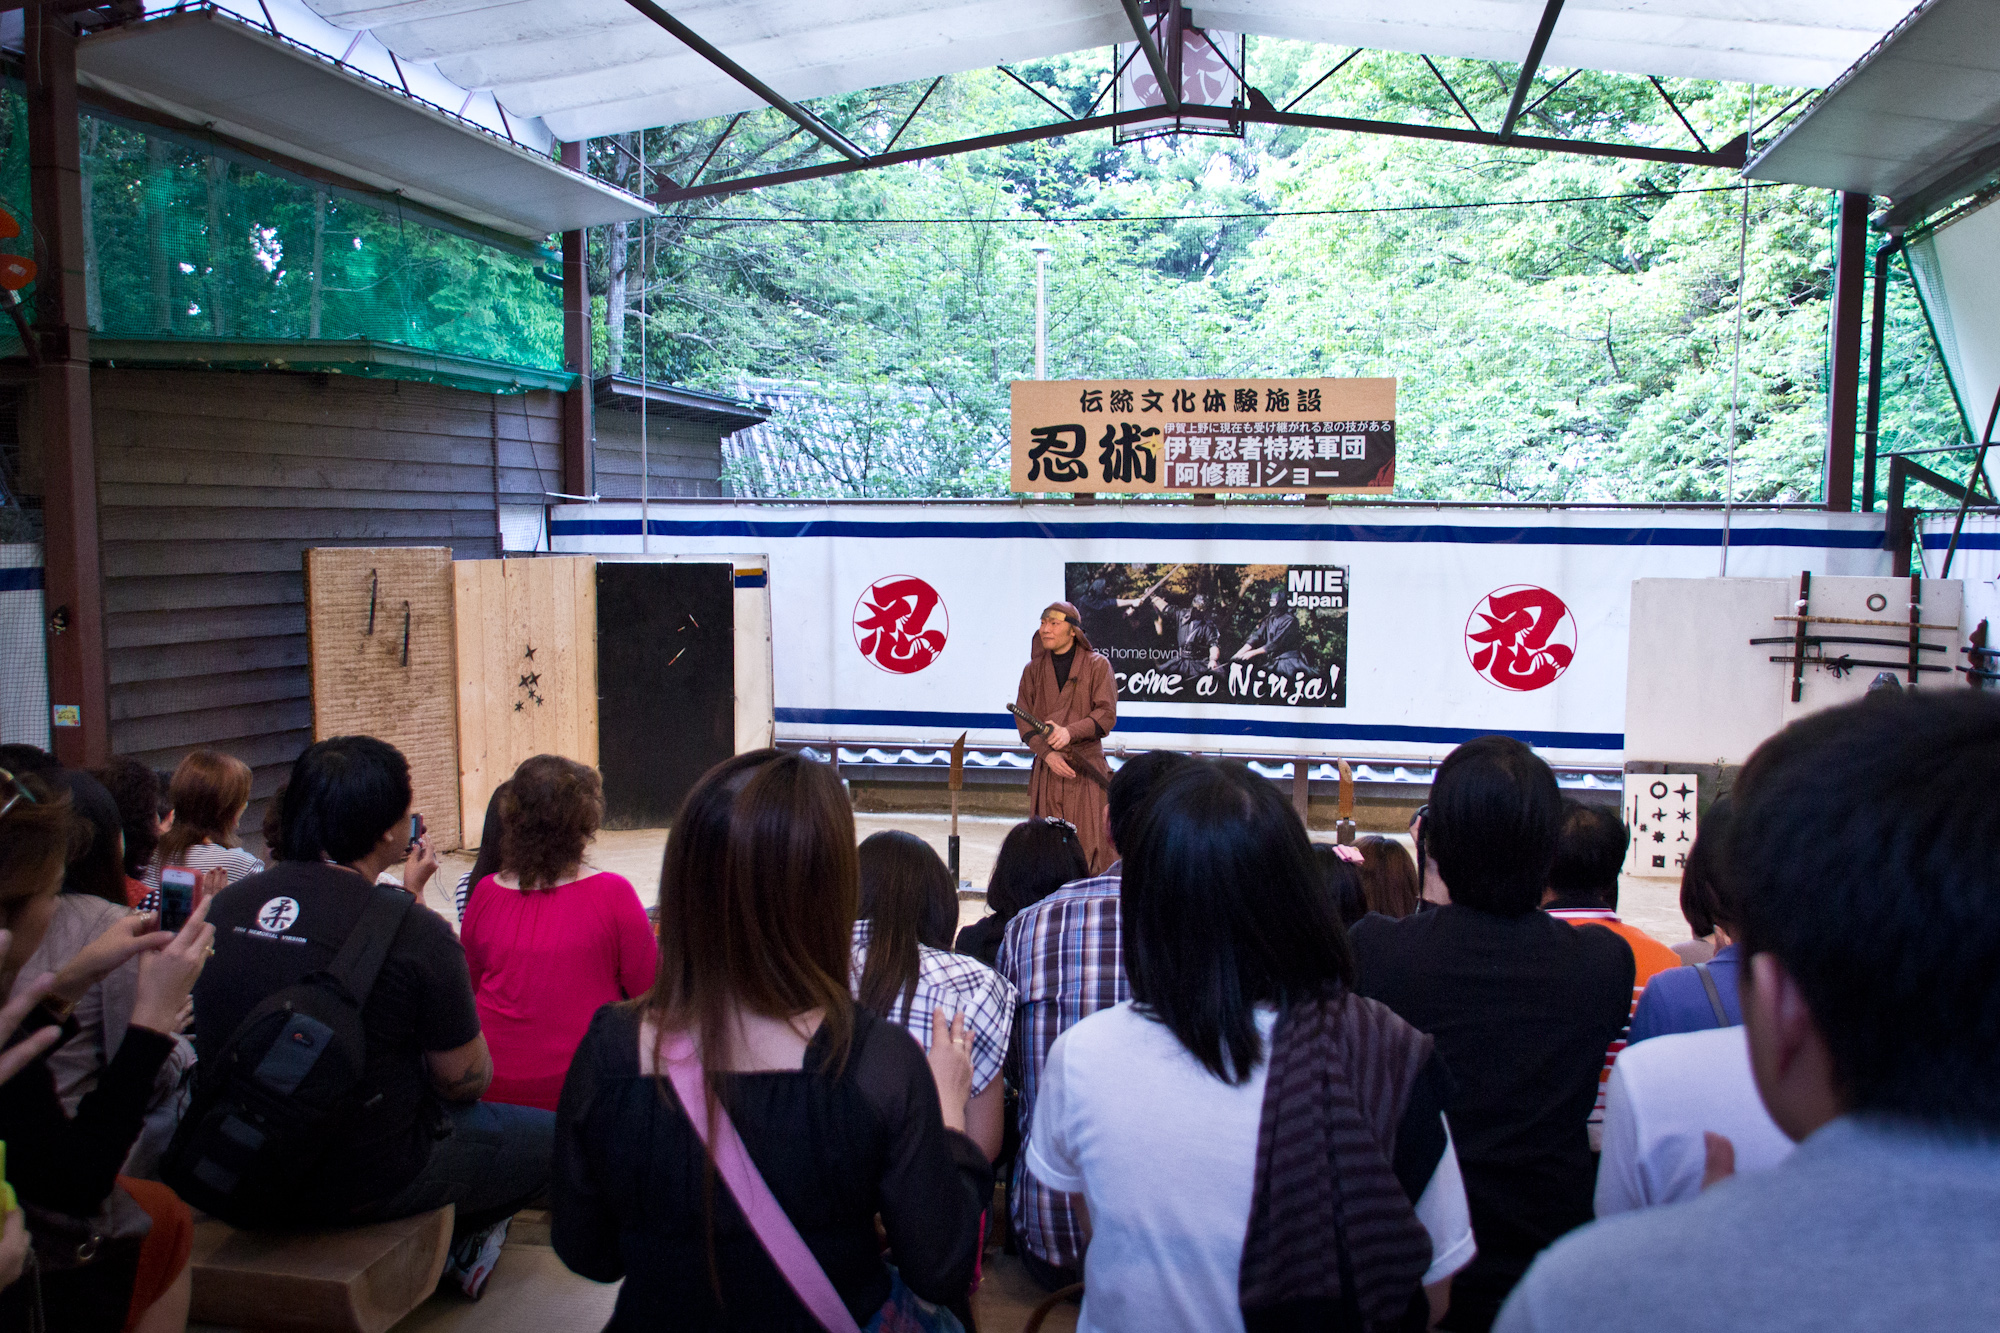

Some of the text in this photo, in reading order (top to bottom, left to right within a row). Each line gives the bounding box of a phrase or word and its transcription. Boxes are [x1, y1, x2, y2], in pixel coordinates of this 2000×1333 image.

[1080, 388, 1322, 414] 伝統文化体験施設
[1164, 421, 1391, 434] 伊賀上野に現在も受け継がれる忍の技がある
[1027, 422, 1161, 484] 忍術
[1164, 435, 1366, 461] 伊賀忍者特殊軍団
[1164, 461, 1340, 488] 「阿修羅」ショー
[1288, 570, 1343, 592] MIE
[1287, 592, 1343, 610] Japan
[1111, 646, 1147, 659] home
[1149, 646, 1182, 660] town!
[1196, 672, 1219, 696] a
[1228, 662, 1341, 705] Ninja!
[262, 899, 293, 929] 柔
[248, 929, 278, 939] MEMORIAL
